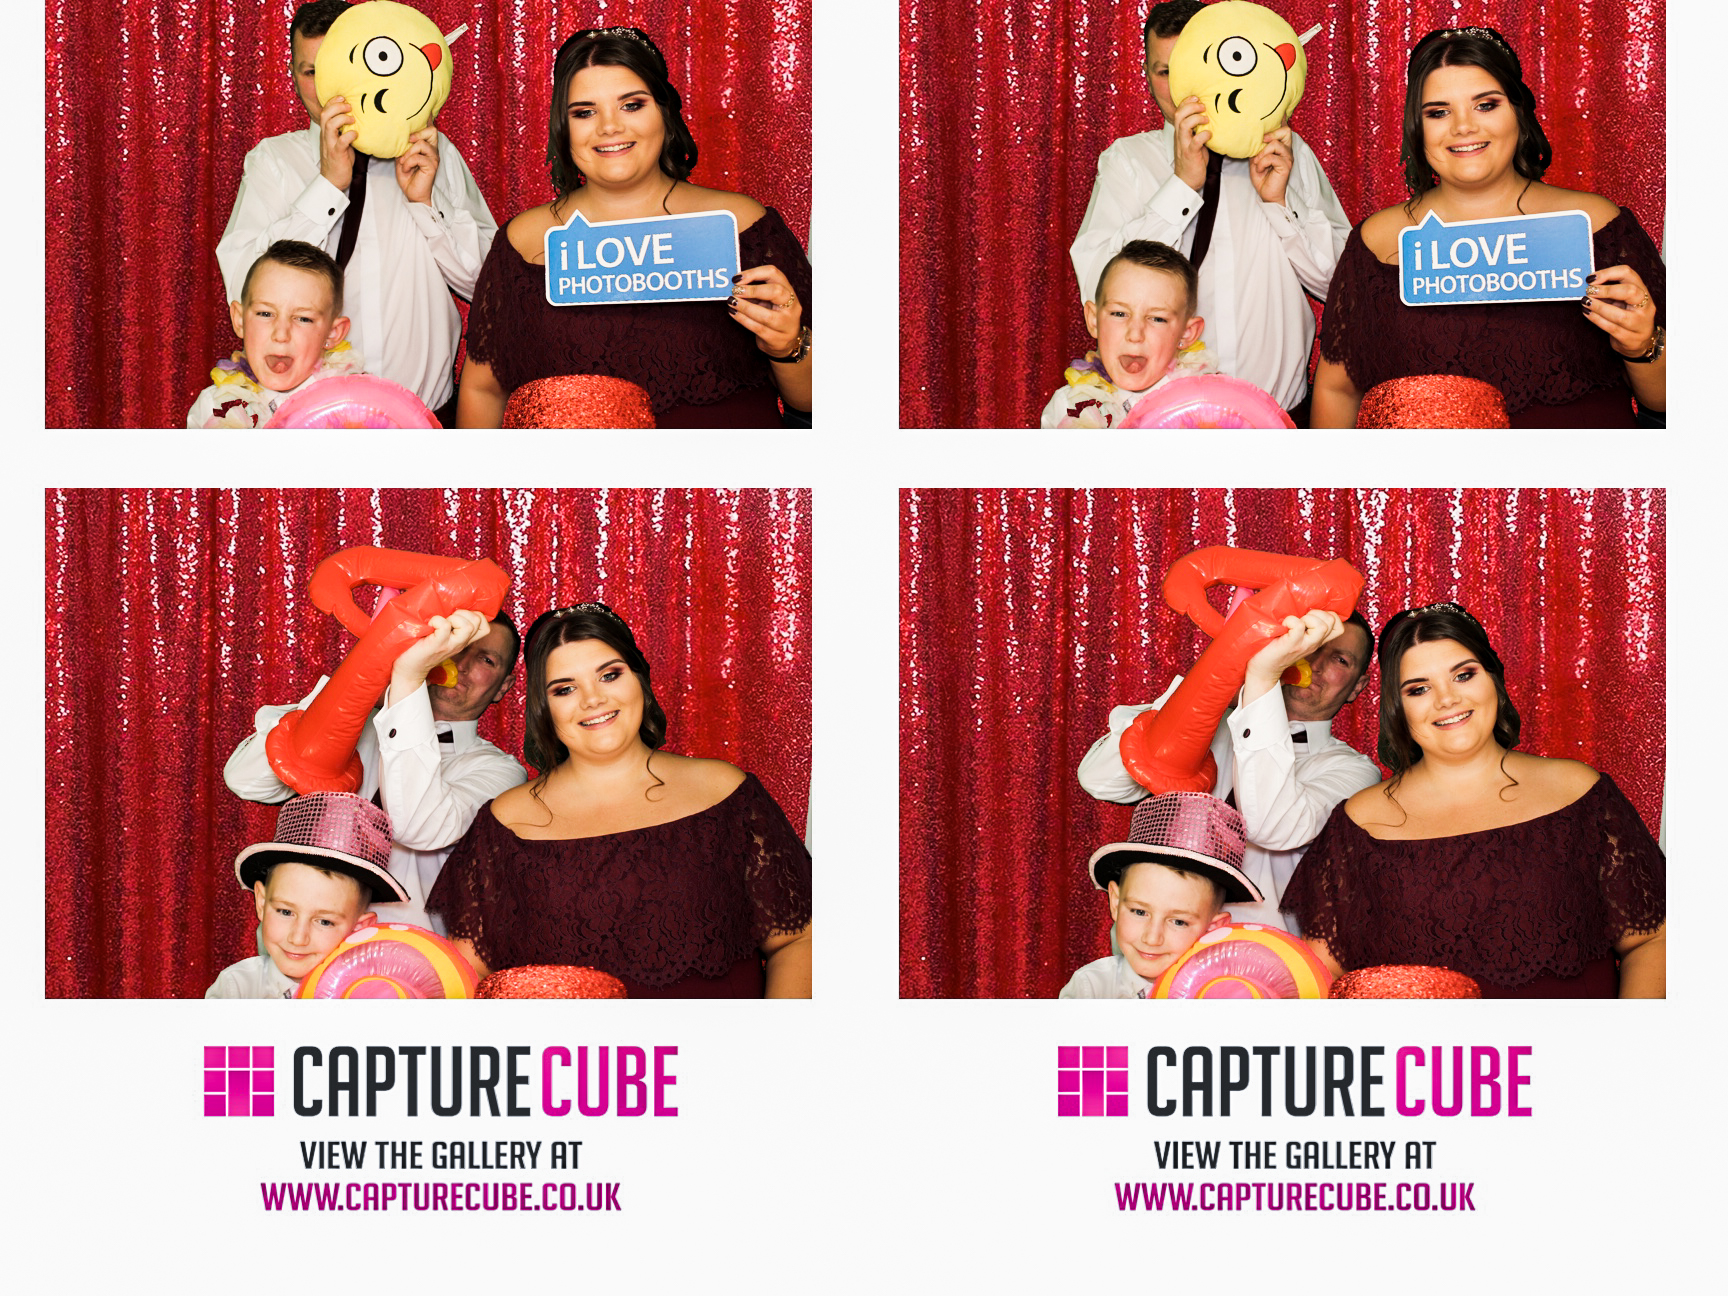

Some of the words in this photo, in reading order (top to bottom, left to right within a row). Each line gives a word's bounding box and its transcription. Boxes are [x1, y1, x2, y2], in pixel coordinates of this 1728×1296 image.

[560, 241, 569, 271] i
[577, 233, 675, 270] LOVE
[1414, 241, 1423, 271] i
[1431, 233, 1529, 270] LOVE
[559, 268, 729, 295] PHOTOBOOTHS
[1413, 268, 1583, 295] PHOTOBOOTHS
